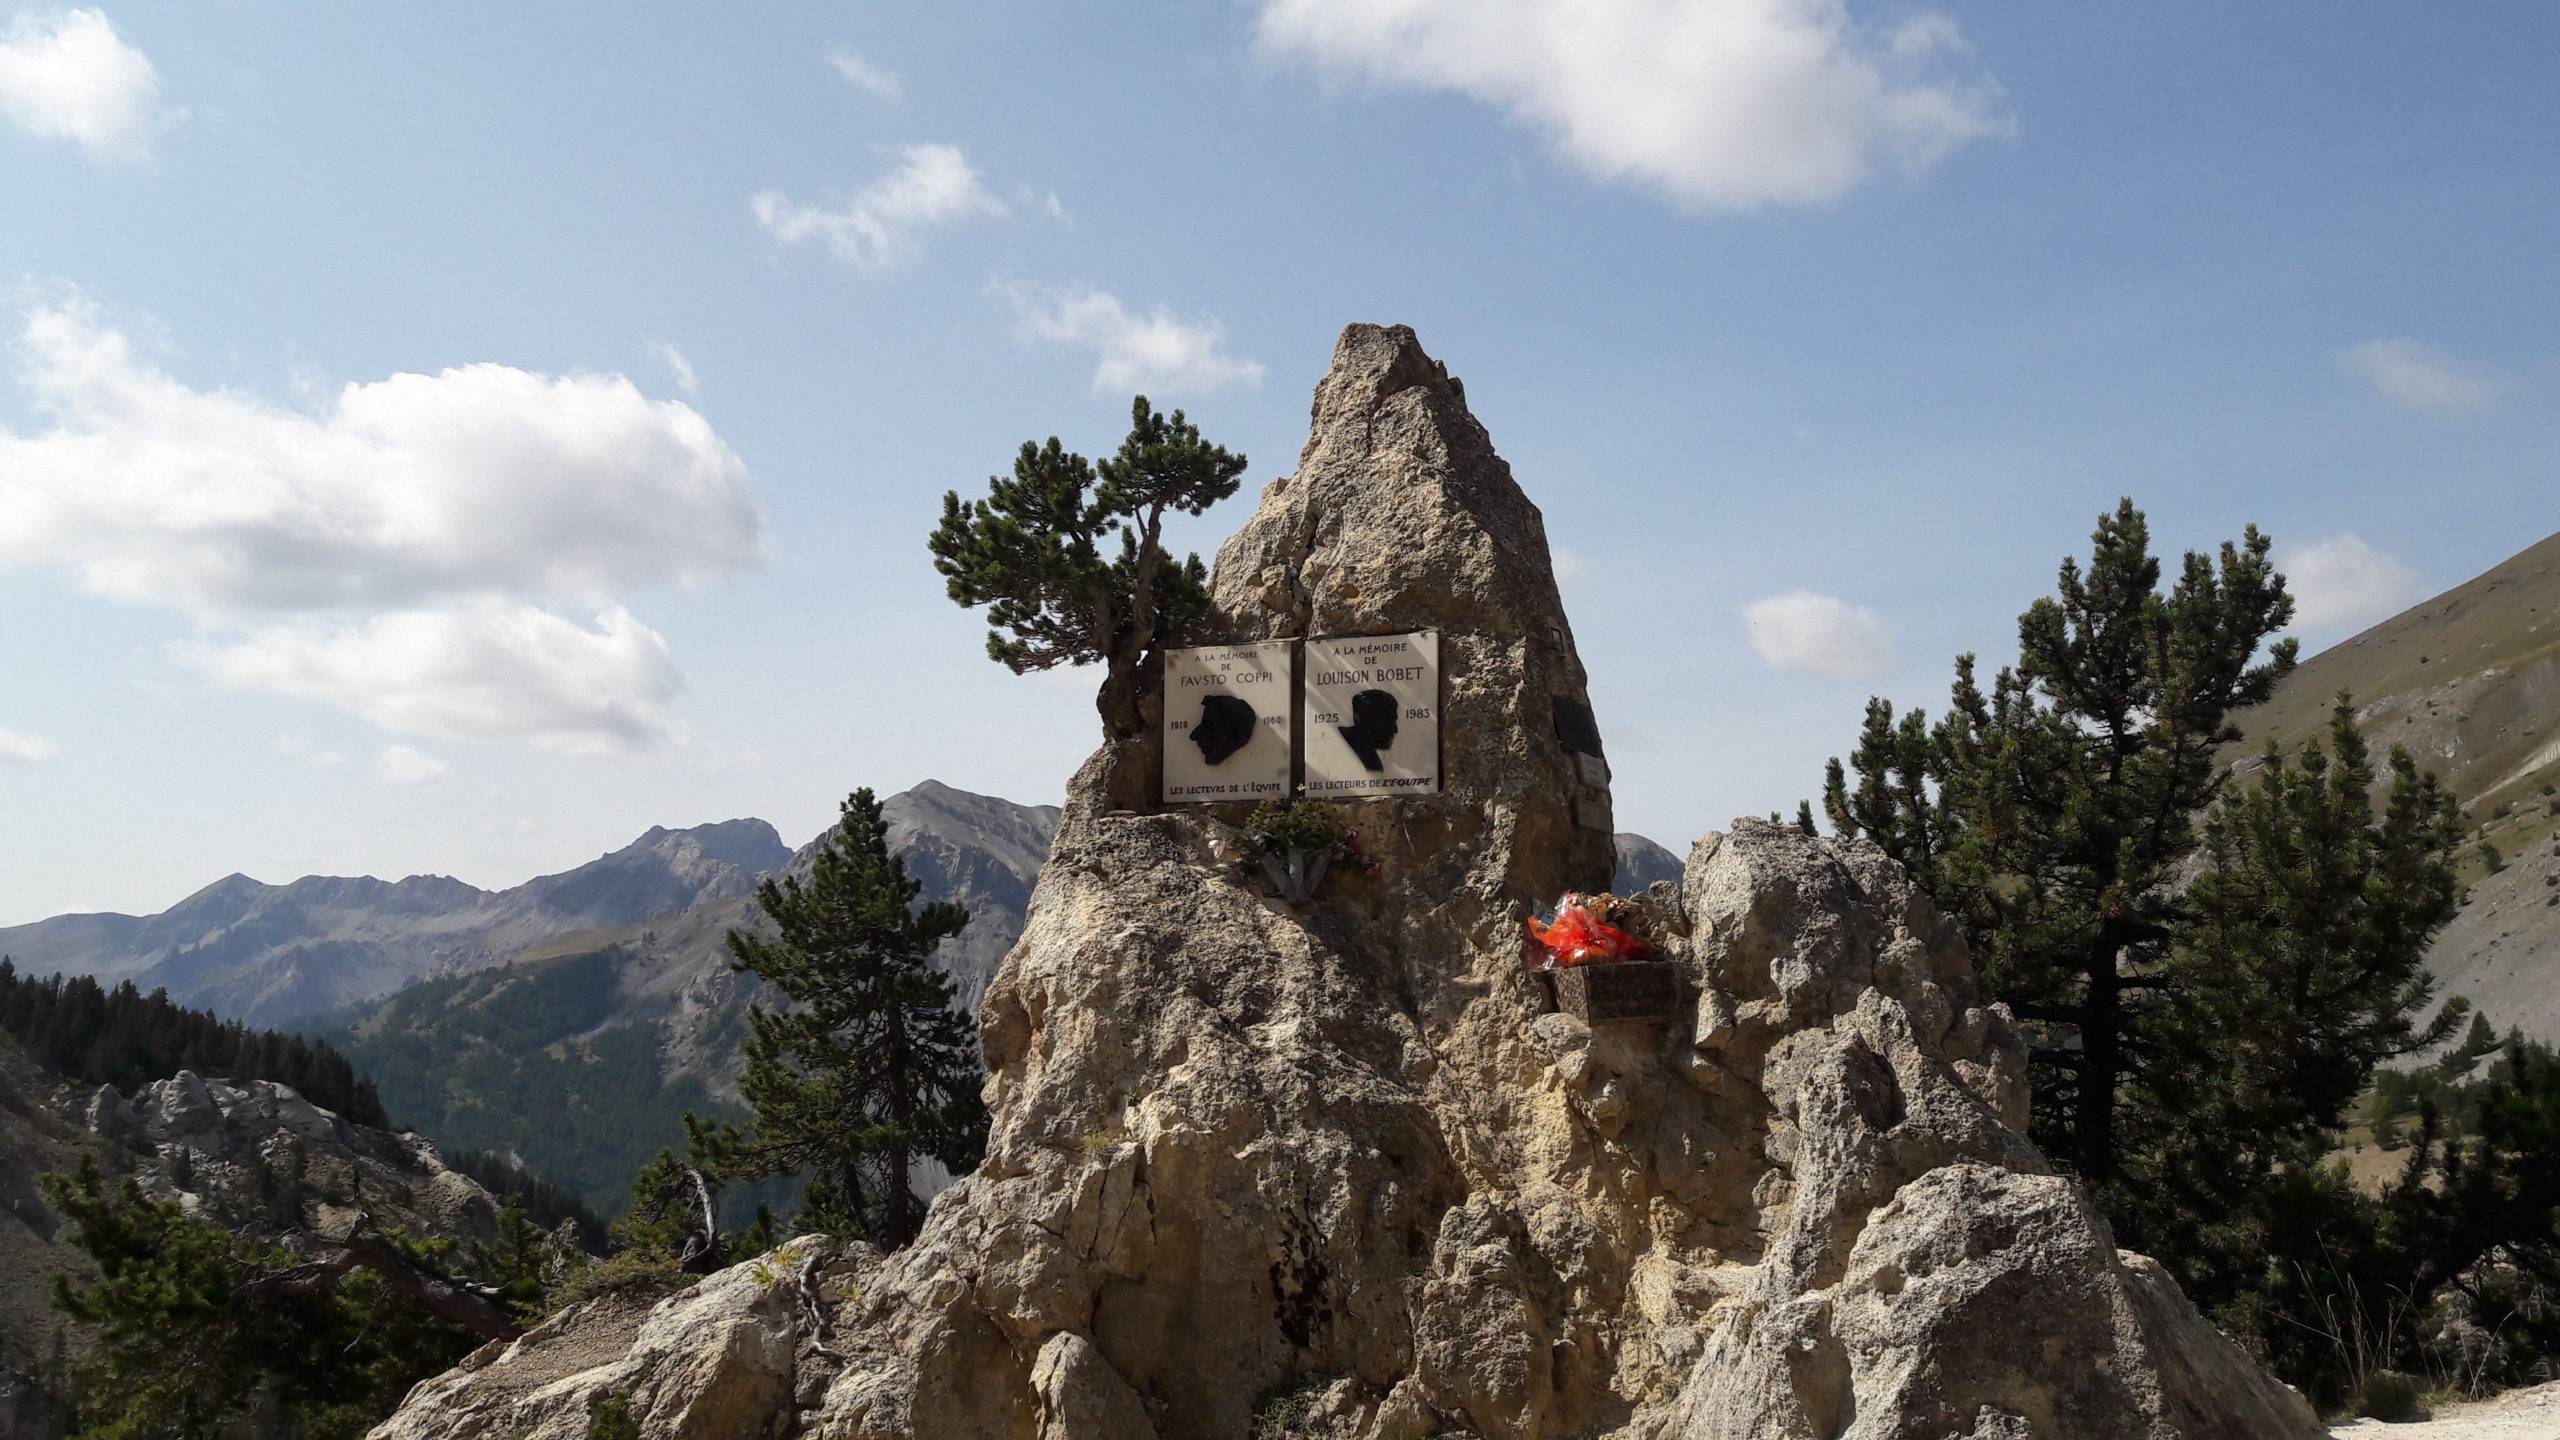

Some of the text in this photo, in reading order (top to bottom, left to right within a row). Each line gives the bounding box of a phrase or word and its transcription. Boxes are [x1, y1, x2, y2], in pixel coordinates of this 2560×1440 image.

[1344, 646, 1354, 654] LA
[1359, 642, 1407, 653] MÉMOIRE
[1220, 650, 1258, 660] MÉMOIRE
[1364, 656, 1377, 664] DE
[1236, 672, 1272, 683] COPPI
[1318, 666, 1423, 685] LOUISON BOBET
[1406, 709, 1430, 718] 1983
[1263, 716, 1280, 724] 1960
[1315, 714, 1339, 724] 1925
[1171, 720, 1188, 730] 1919
[1310, 782, 1323, 790] LES
[1326, 780, 1366, 789] LECTEURS
[1370, 780, 1382, 788] DE
